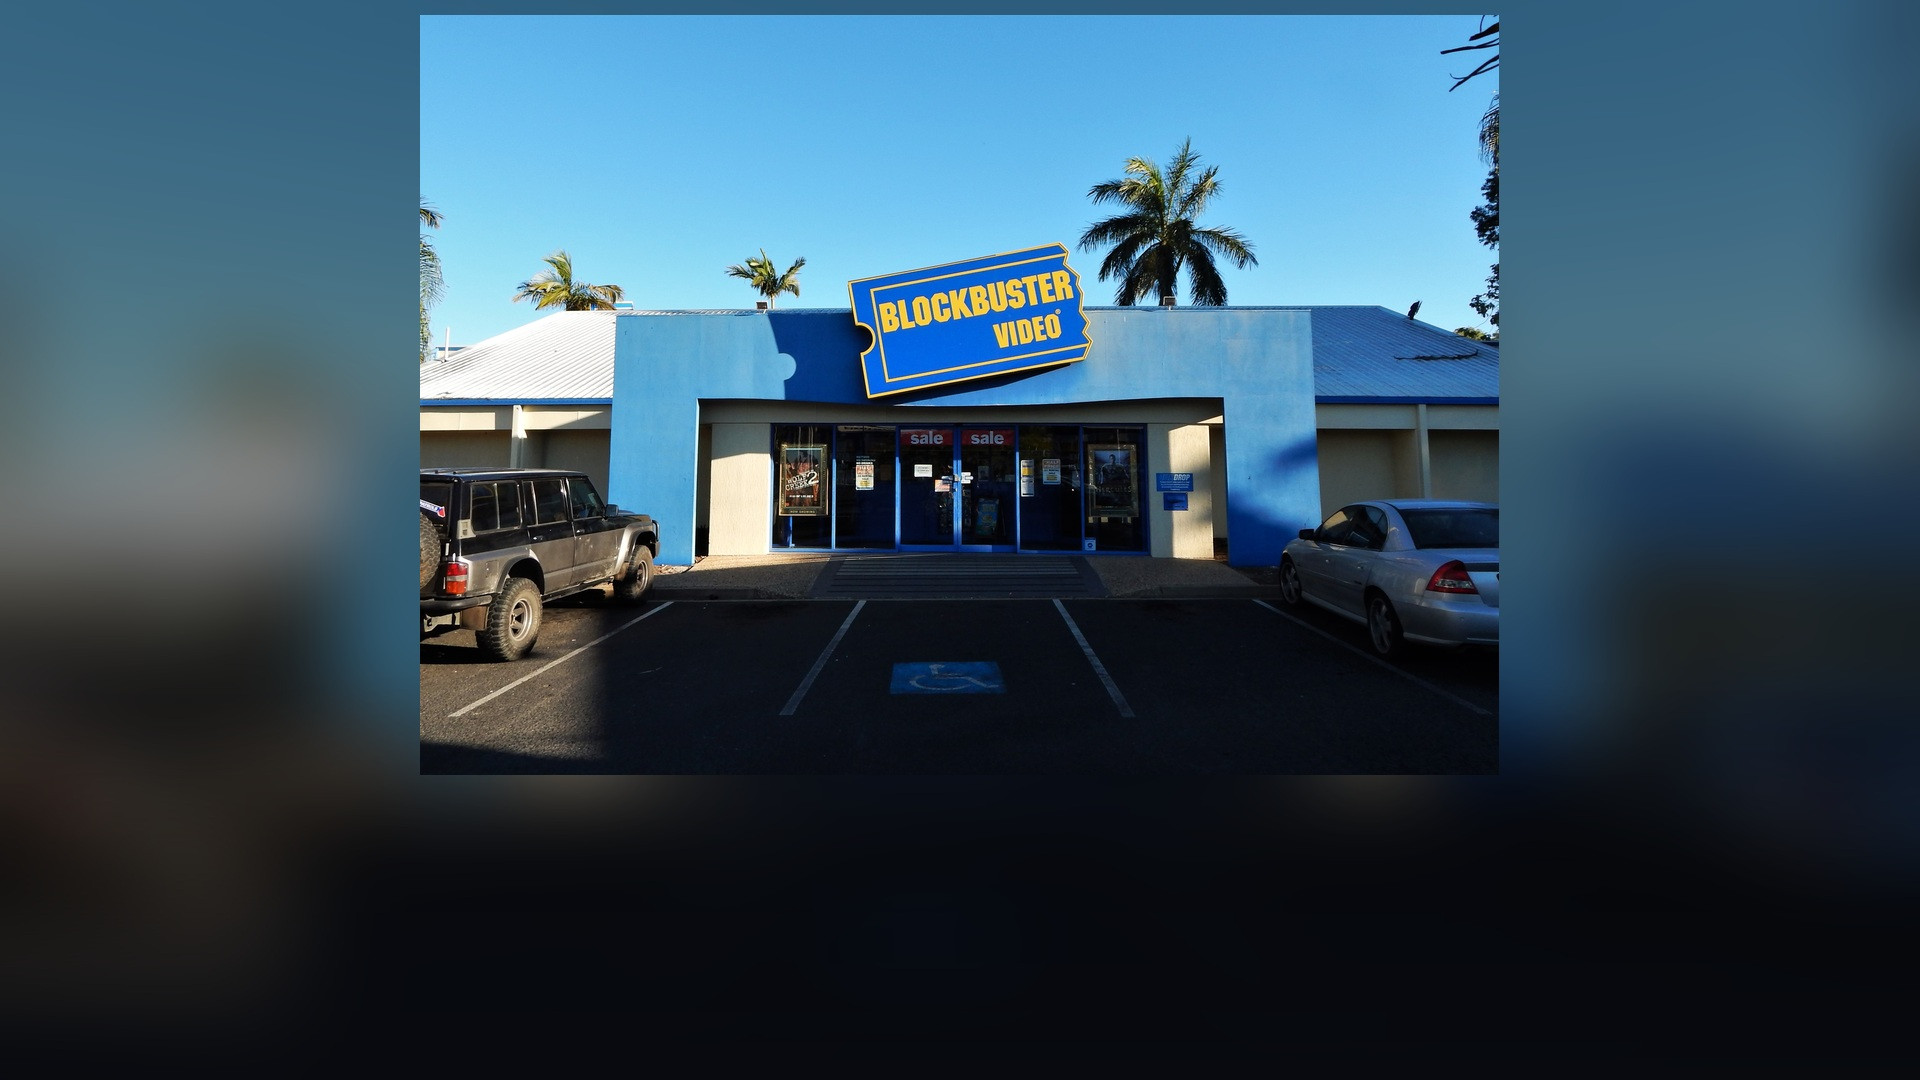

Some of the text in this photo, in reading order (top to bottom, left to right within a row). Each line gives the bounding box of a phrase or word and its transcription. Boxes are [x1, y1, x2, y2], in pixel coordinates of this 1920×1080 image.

[879, 270, 1075, 333] BLOCKBUSTER
[992, 314, 1062, 349] VIDEO
[910, 430, 944, 445] sale
[970, 430, 1004, 445] sale
[806, 470, 820, 485] 2
